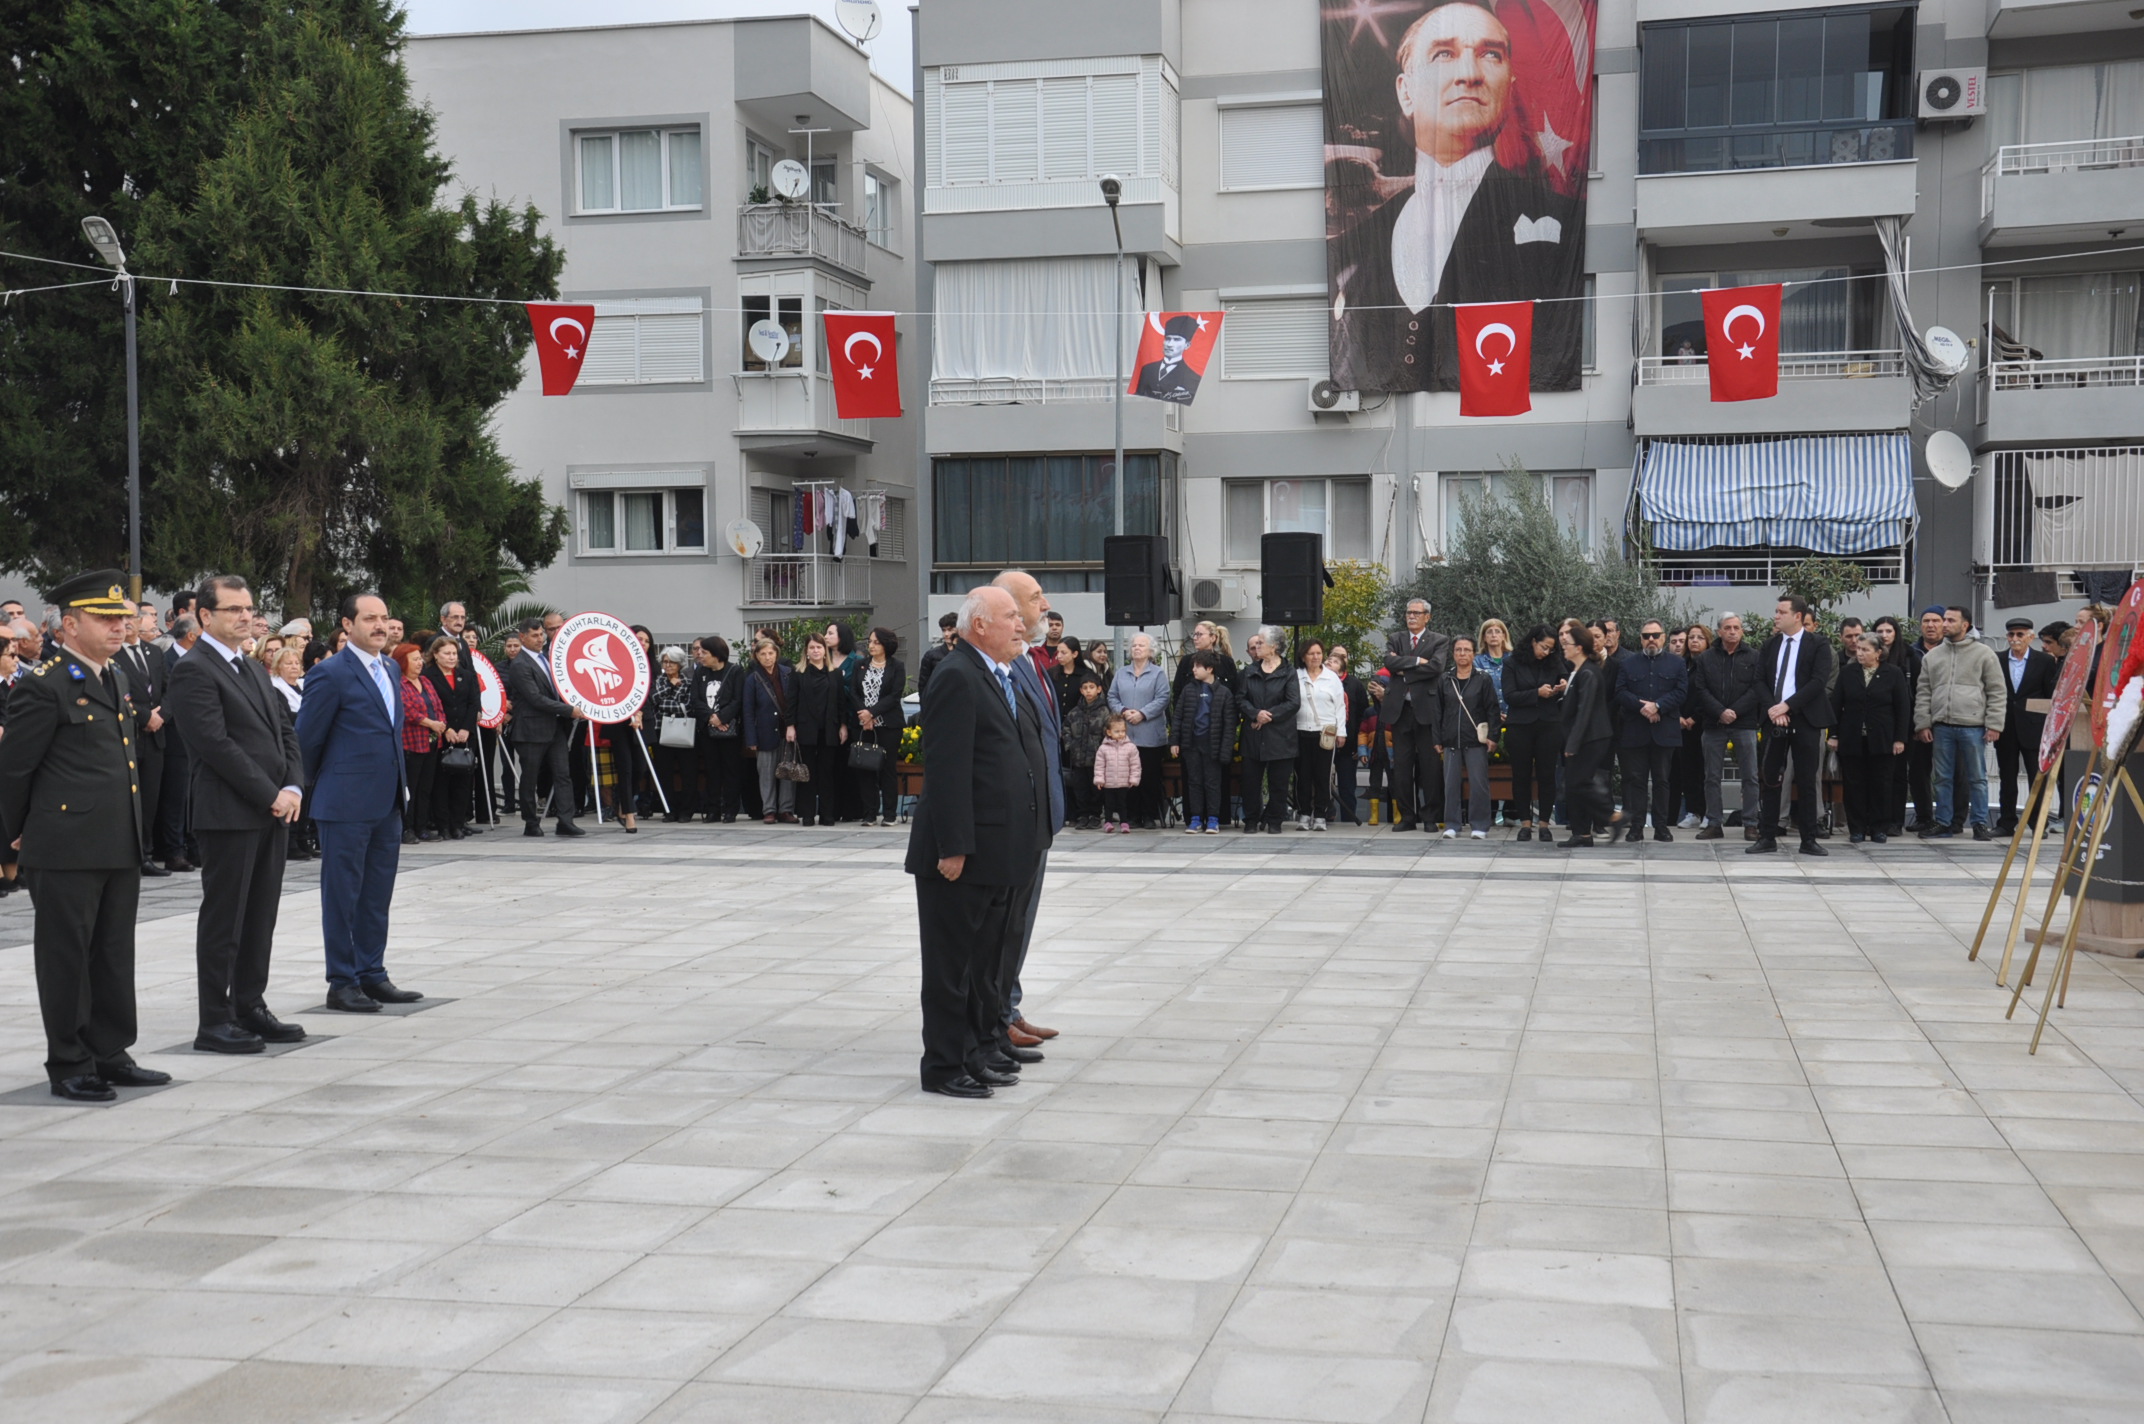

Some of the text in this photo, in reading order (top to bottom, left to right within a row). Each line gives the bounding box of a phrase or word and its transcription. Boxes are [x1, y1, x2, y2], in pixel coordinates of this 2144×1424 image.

[1967, 75, 1977, 109] VESTEL
[563, 617, 619, 638] MUHTARLAR
[569, 687, 644, 719] SALİHLİ ŞUBESİ
[600, 697, 616, 705] 1970
